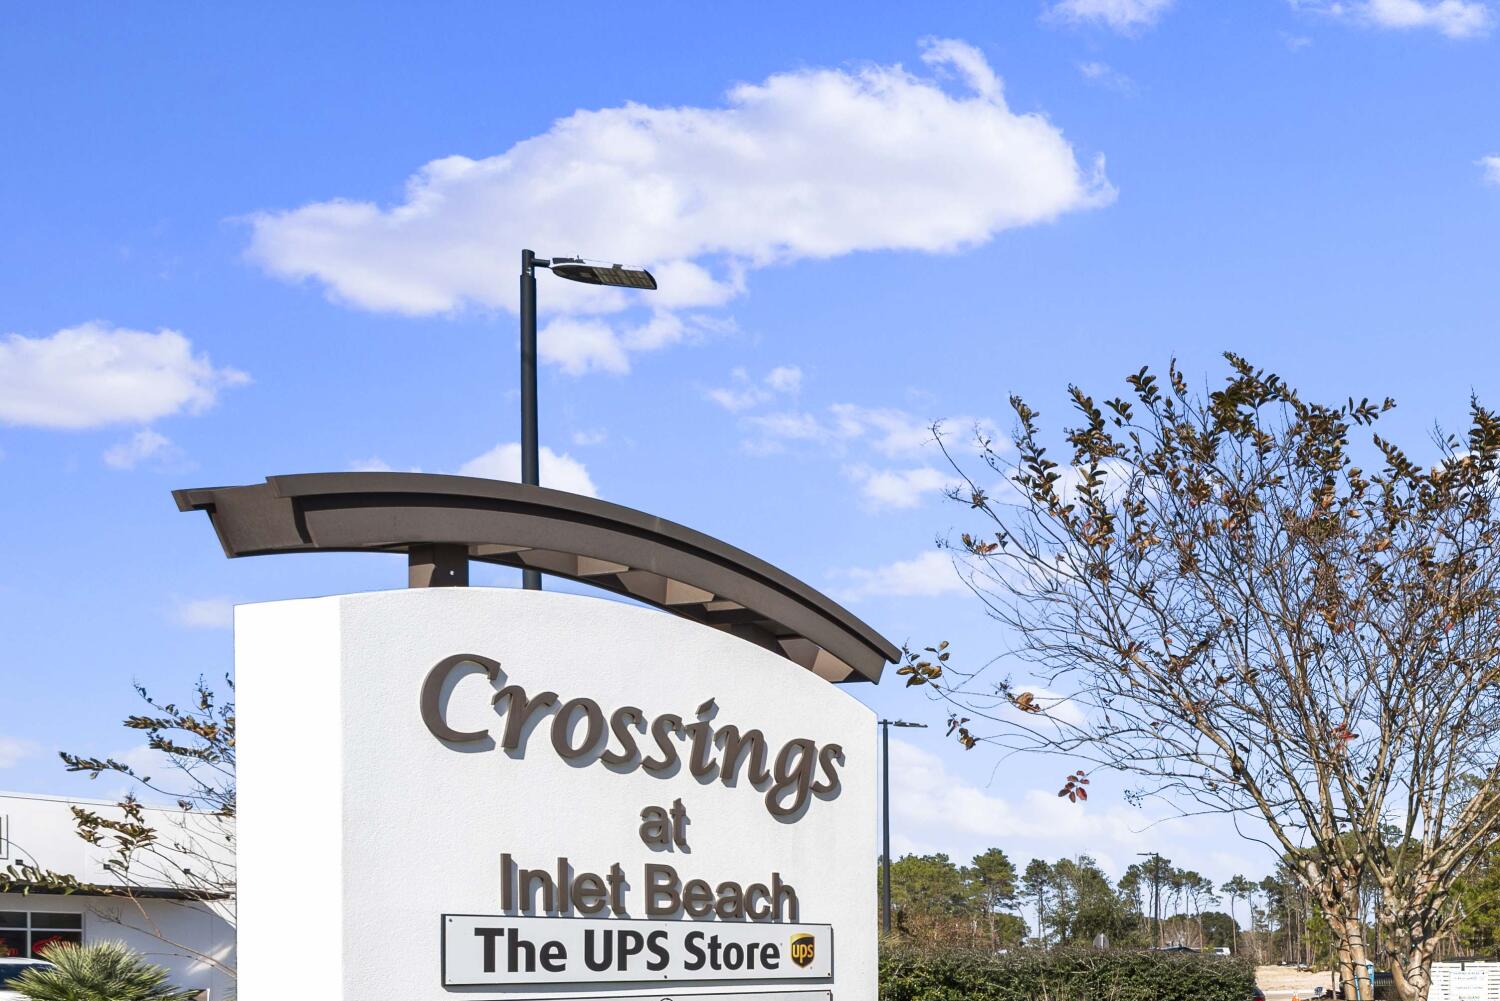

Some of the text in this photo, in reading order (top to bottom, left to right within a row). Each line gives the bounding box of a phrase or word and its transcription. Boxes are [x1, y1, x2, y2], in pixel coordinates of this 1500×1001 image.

[420, 654, 843, 816] Crossings
[639, 798, 689, 846] at
[500, 853, 797, 922] Inlet Beach
[474, 927, 780, 973] The UPS Store
[790, 943, 815, 968] ups
